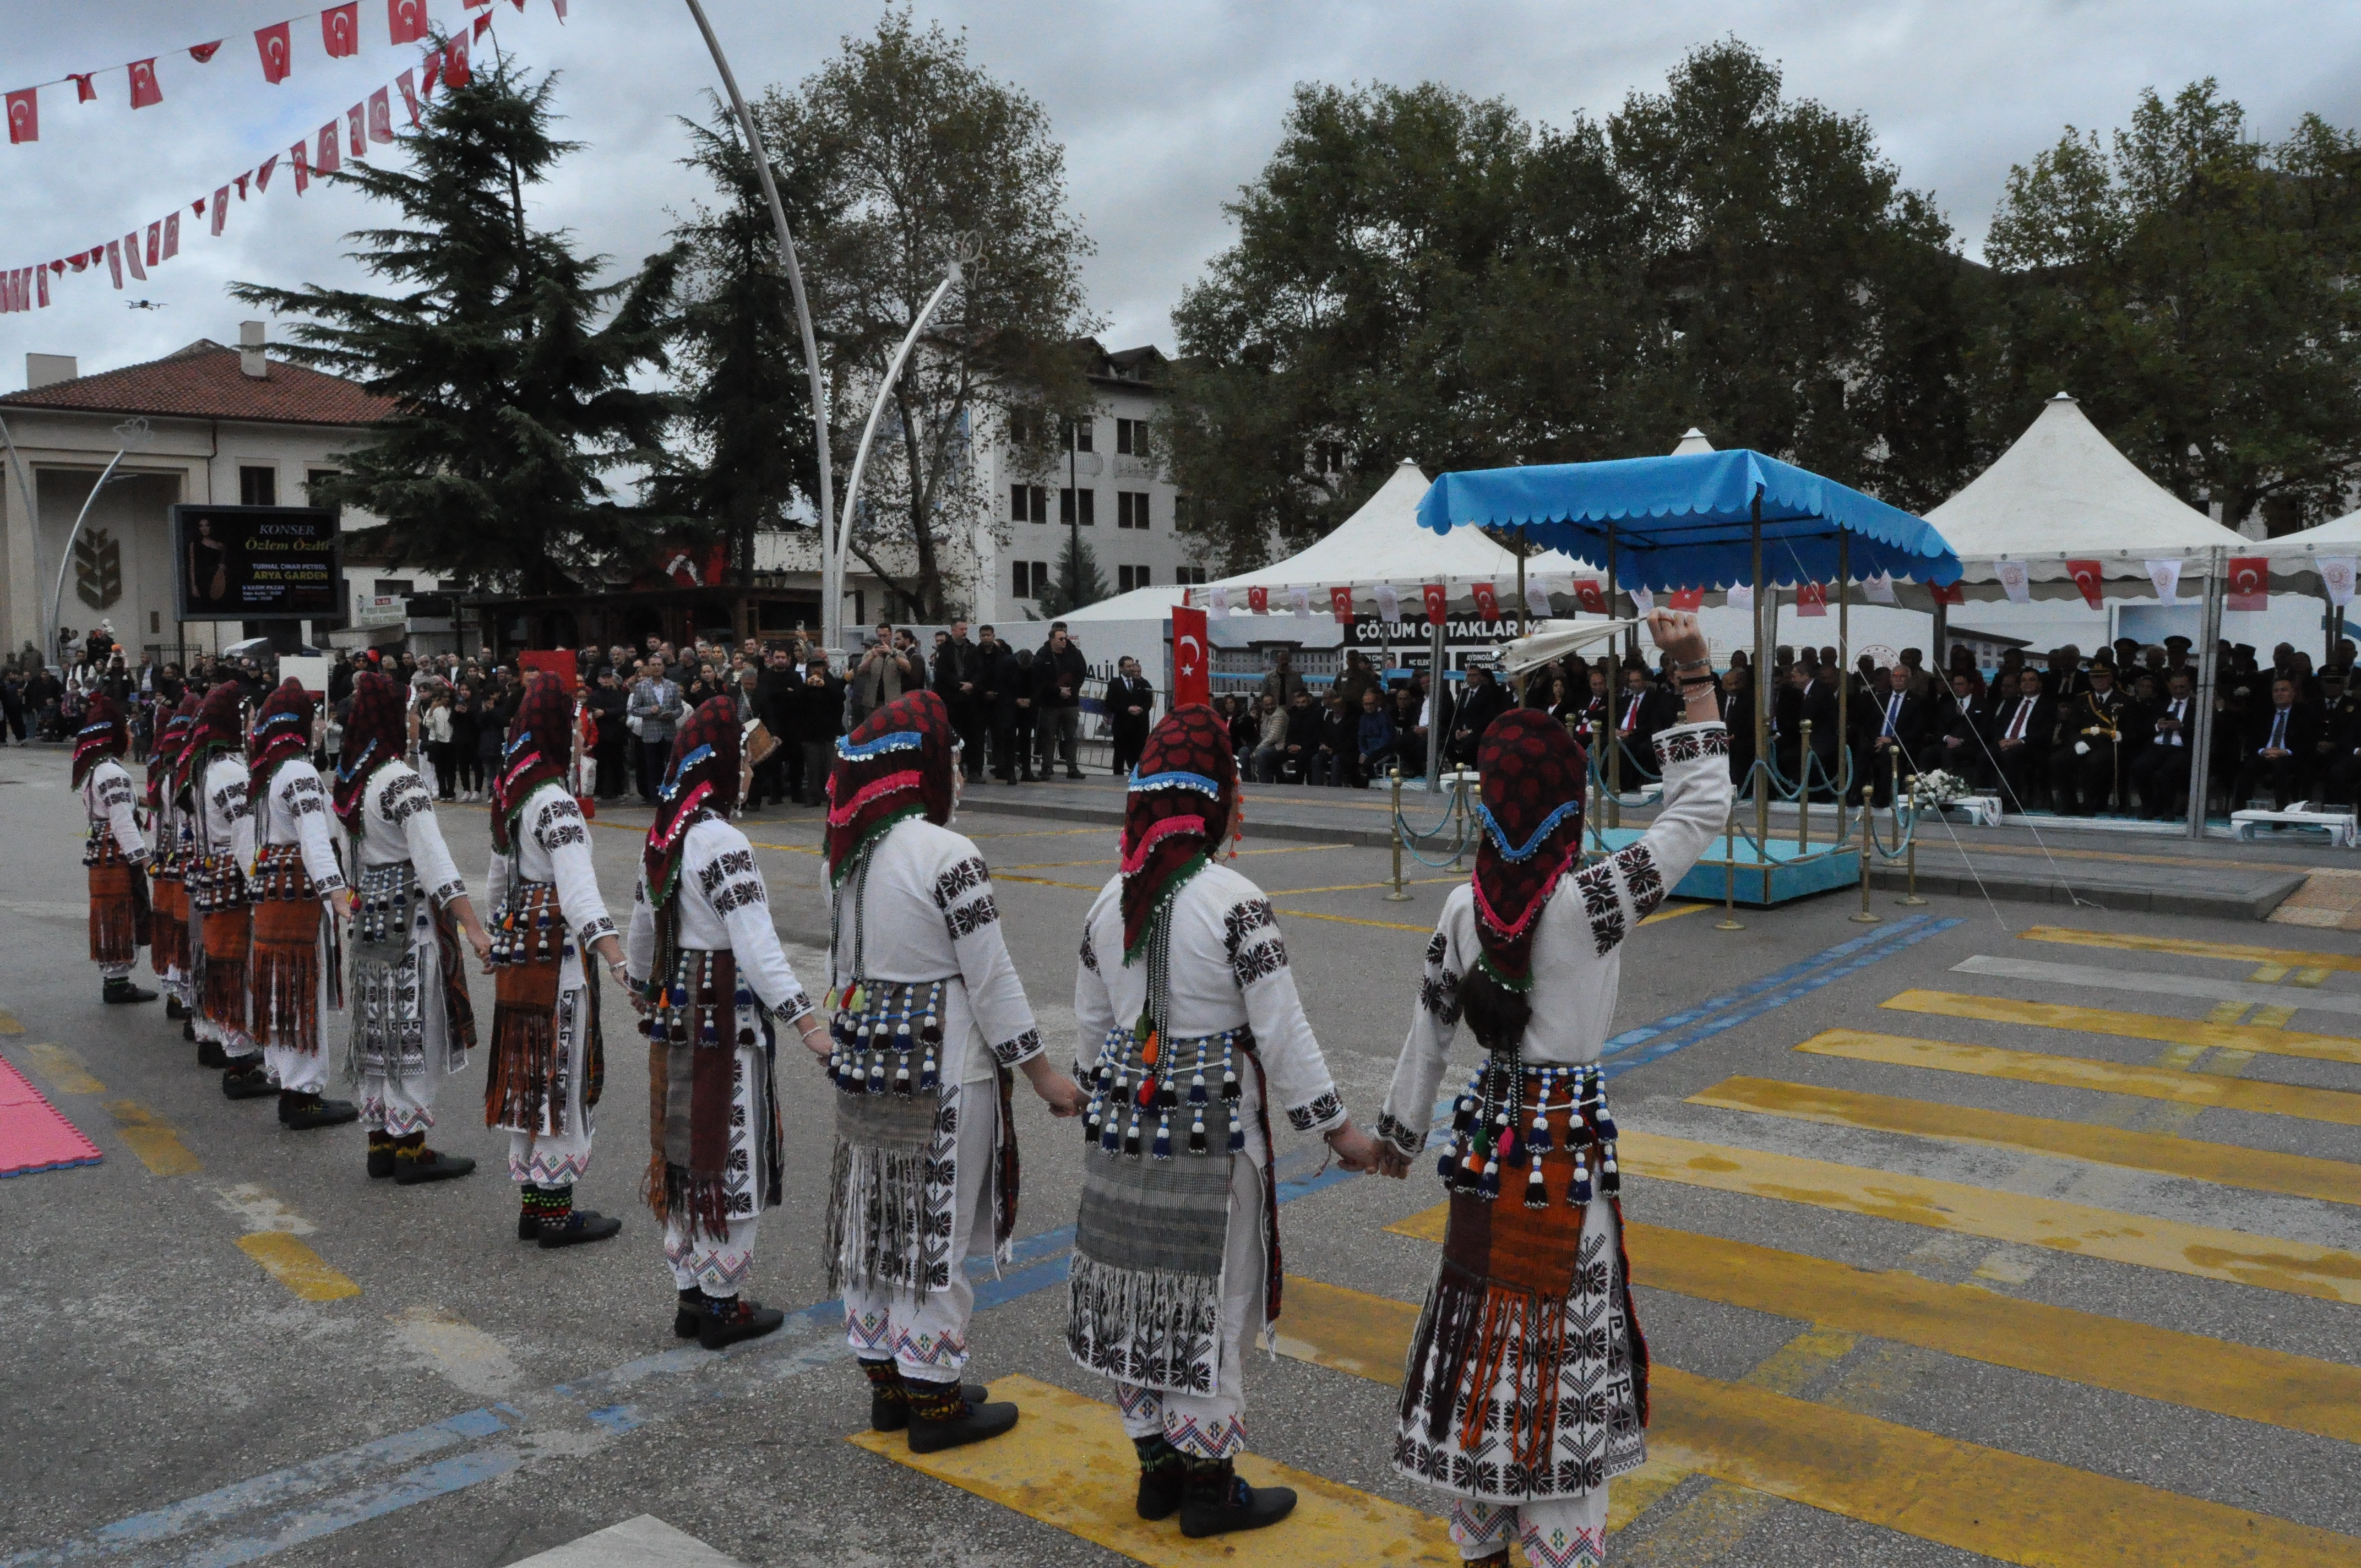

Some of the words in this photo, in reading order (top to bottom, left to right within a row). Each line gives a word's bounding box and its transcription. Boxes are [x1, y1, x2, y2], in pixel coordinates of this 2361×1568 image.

[259, 525, 315, 535] KONSER
[245, 537, 289, 550] Özlem
[253, 571, 282, 580] ARYA
[285, 571, 328, 580] GARDEN
[1417, 657, 1431, 666] ELEK
[1086, 660, 1120, 681] ALİL
